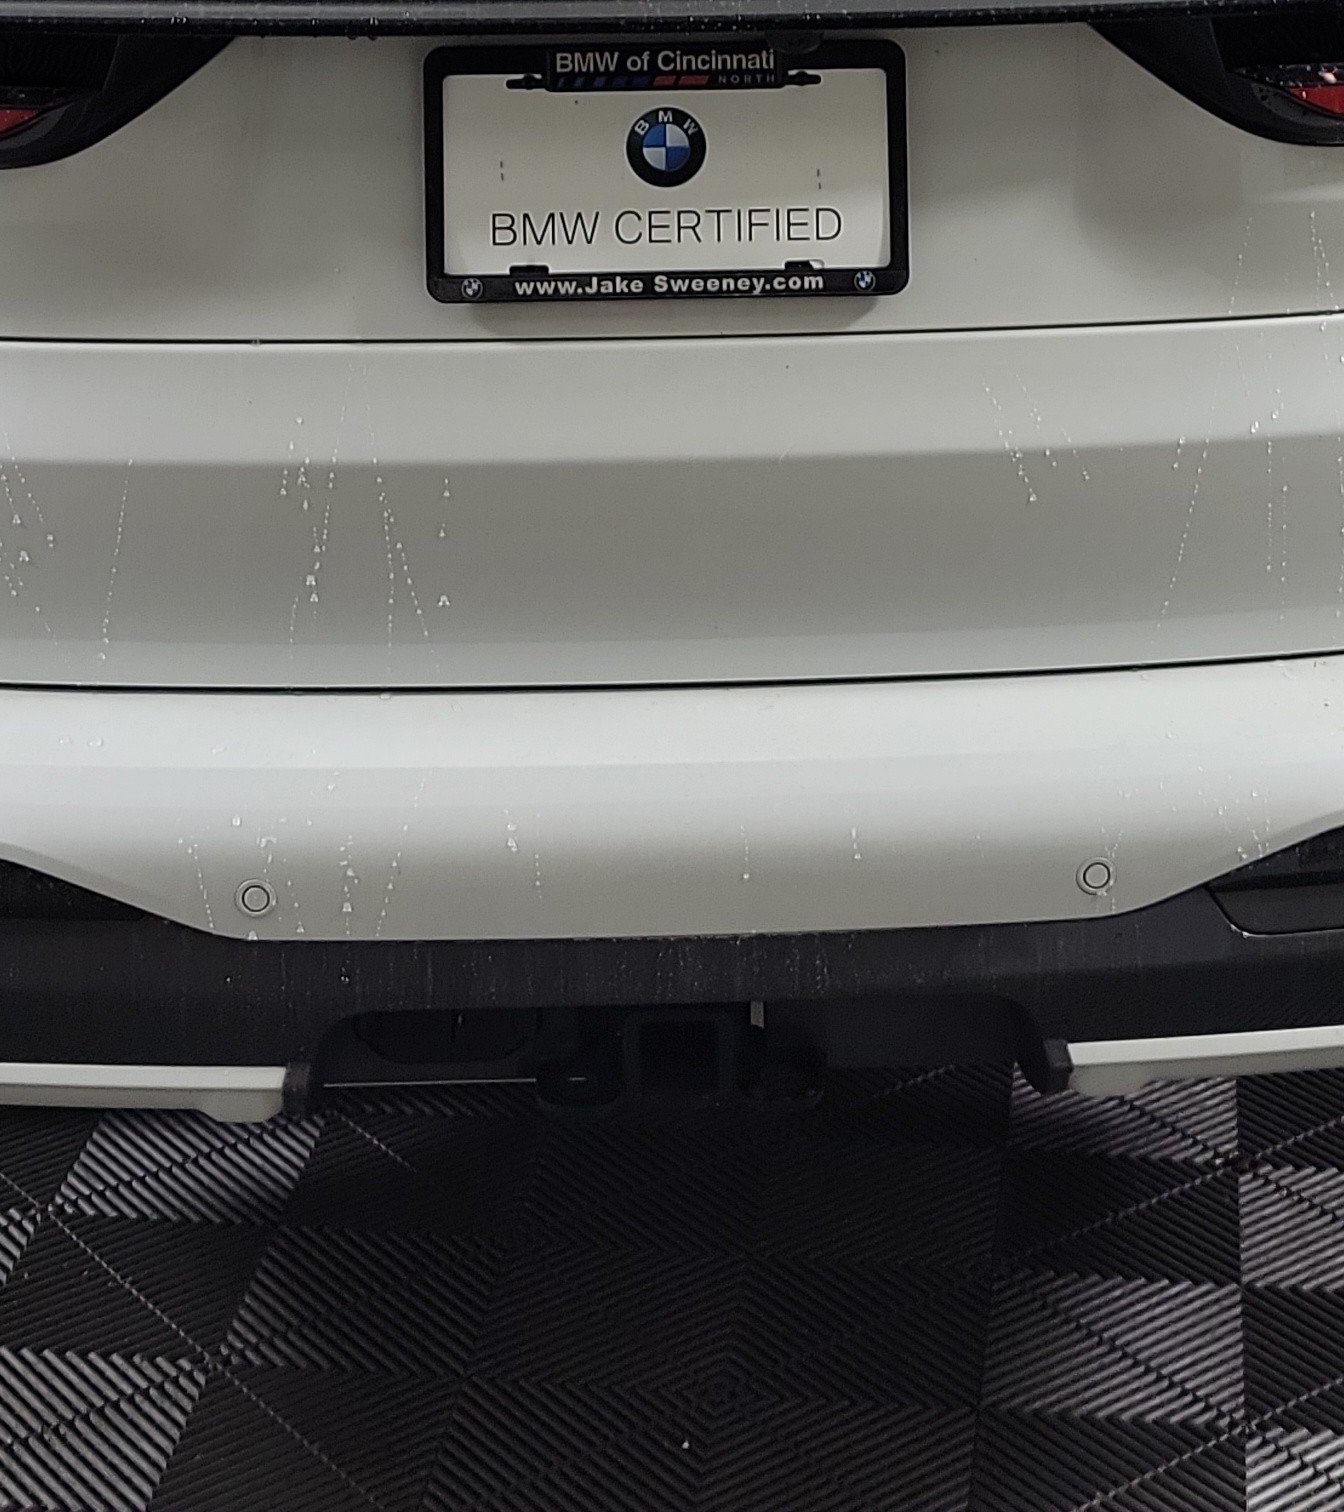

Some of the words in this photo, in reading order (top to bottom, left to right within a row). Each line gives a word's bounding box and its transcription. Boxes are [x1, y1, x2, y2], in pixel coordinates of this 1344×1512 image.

[556, 51, 619, 73] BMW
[626, 50, 650, 72] of
[657, 48, 775, 72] Cincinnati
[718, 73, 775, 84] NORTH
[634, 110, 700, 137] BMW
[490, 211, 600, 247] BMW
[613, 207, 843, 245] CERTIFIED
[514, 276, 644, 296] www.Jake
[653, 274, 825, 296] Sweeney.com
